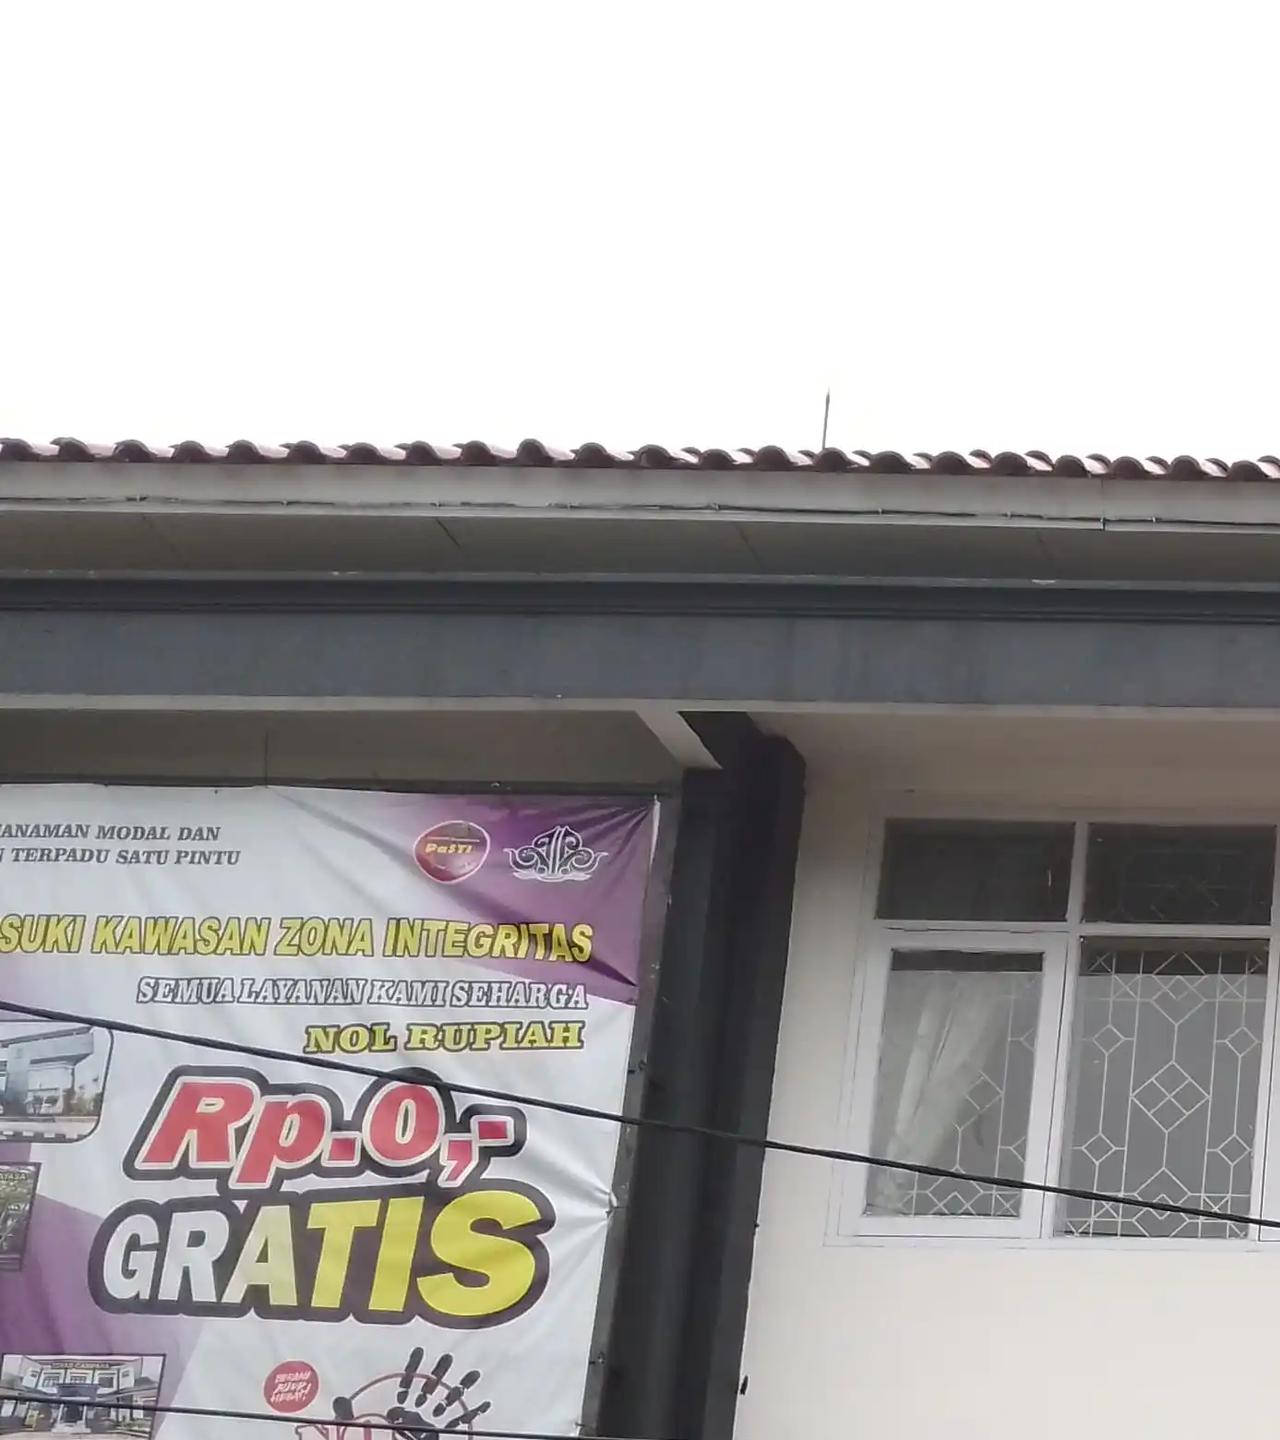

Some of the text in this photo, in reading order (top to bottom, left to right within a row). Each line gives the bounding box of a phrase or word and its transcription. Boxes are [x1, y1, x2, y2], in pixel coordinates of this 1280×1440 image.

[0, 824, 221, 842] ANAMAN MODAL DAN
[11, 847, 111, 864] TERPADU
[115, 849, 170, 865] SATU
[174, 850, 241, 866] PINTU
[0, 913, 595, 963] SUKI KAWASAN ZONA INTEGRITAS
[137, 975, 589, 1010] SEMUA LAYANAN KAMI SEHARGA
[303, 1020, 586, 1054] NOL RUPIAH
[100, 1188, 545, 1318] GRATIS
